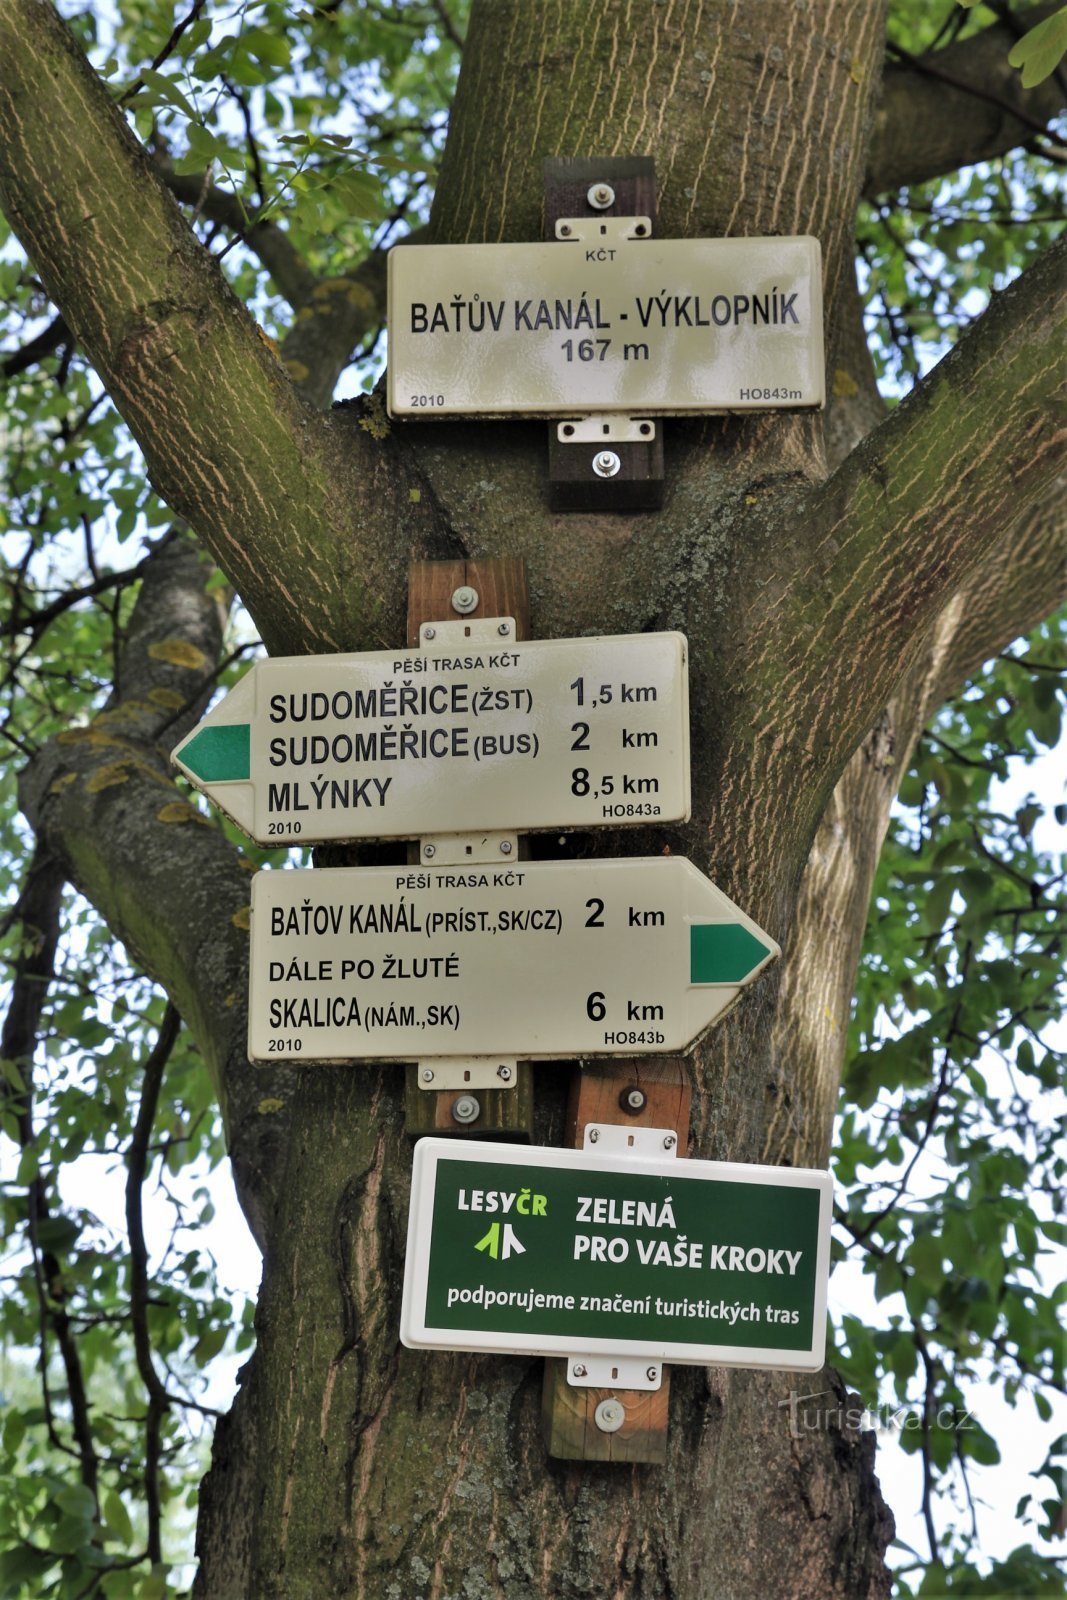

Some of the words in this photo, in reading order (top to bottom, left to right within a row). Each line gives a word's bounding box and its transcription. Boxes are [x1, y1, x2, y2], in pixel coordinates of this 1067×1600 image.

[585, 248, 617, 263] KČT
[410, 292, 506, 333] BAŤŮV
[514, 291, 611, 330] KANÁL
[635, 286, 800, 328] VÝKLOPNÍK
[560, 339, 611, 362] 167
[623, 343, 650, 361] m
[410, 394, 445, 407] 2010
[740, 388, 802, 400] HO843m
[393, 657, 429, 674] PĚŠÍ
[432, 656, 486, 672] TRASA
[489, 653, 520, 669] KČT
[570, 677, 613, 708] 1,5
[621, 683, 658, 704] km
[570, 722, 591, 751] 2
[622, 728, 659, 748] km
[268, 773, 393, 813] MLÝNKY
[570, 768, 615, 799] 8,5
[623, 774, 660, 795] km
[602, 803, 661, 818] HO843a
[268, 821, 302, 835] 2010
[395, 873, 432, 890] PĚŠÍ
[435, 874, 490, 889] TRASA
[492, 872, 525, 887] KČT
[271, 899, 343, 937] BAŤOV
[349, 896, 422, 934] KANÁL
[585, 898, 605, 928] 2
[628, 907, 665, 927] km
[269, 956, 333, 982] DÁLE
[340, 959, 375, 980] PO
[381, 953, 460, 979] ŽLUTÉ
[586, 991, 607, 1022] 6
[627, 1001, 665, 1021] km
[268, 1039, 302, 1052] 2010
[604, 1030, 665, 1046] HO843b
[457, 1187, 548, 1216] LESYČR
[576, 1195, 677, 1229] ZELENÁ
[573, 1234, 629, 1262] PRO
[635, 1235, 703, 1269] VAŠE
[710, 1245, 802, 1275] KROKY
[447, 1284, 575, 1313] podporujeme
[579, 1294, 650, 1314] značení
[654, 1297, 761, 1324] turistických
[765, 1304, 800, 1324] tras
